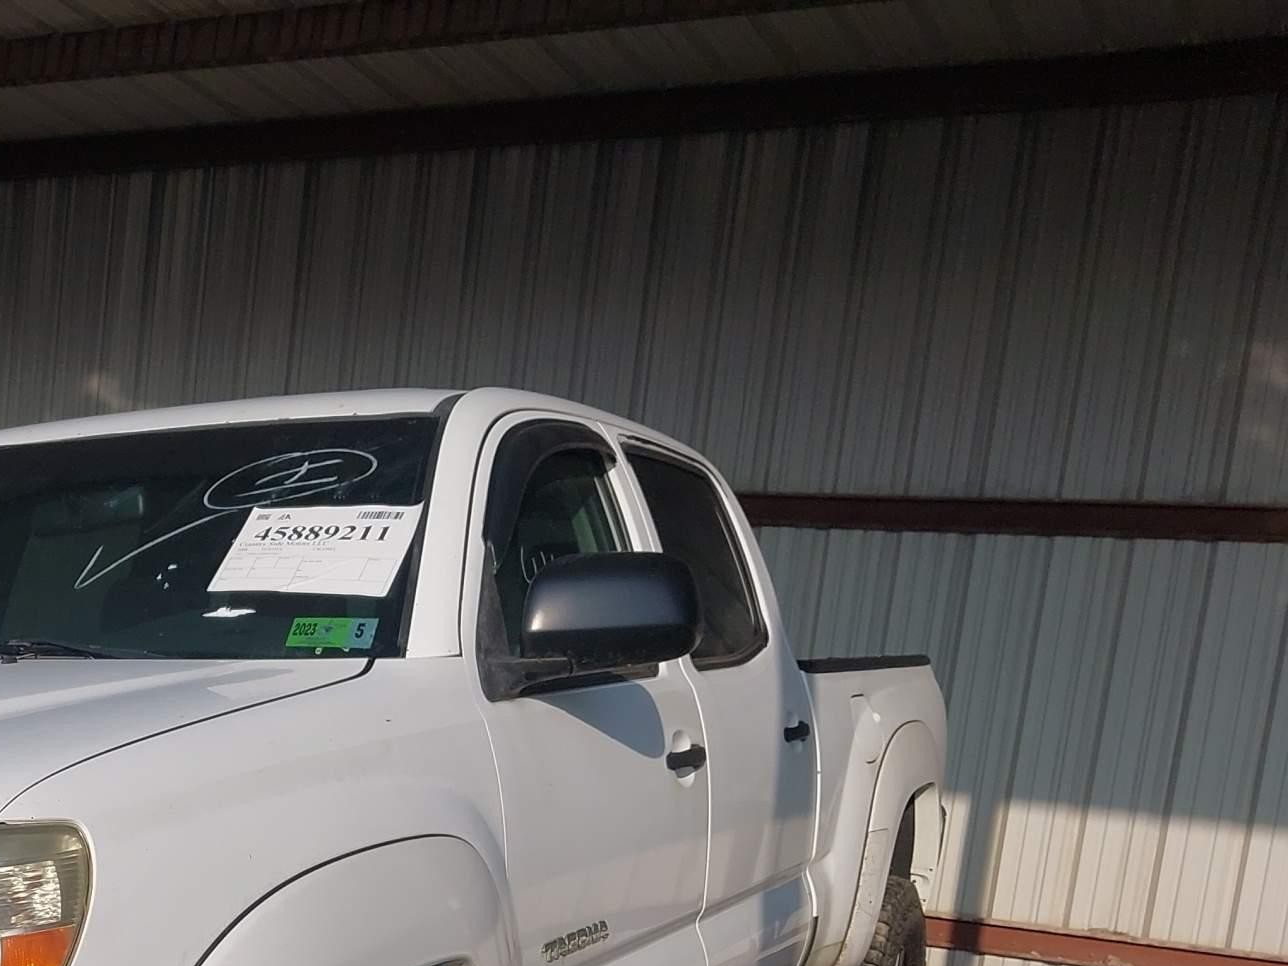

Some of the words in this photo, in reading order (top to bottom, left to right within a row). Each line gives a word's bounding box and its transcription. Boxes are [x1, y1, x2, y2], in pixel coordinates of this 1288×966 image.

[254, 525, 391, 542] 45889211
[292, 622, 319, 637] 2023
[354, 622, 367, 639] 5
